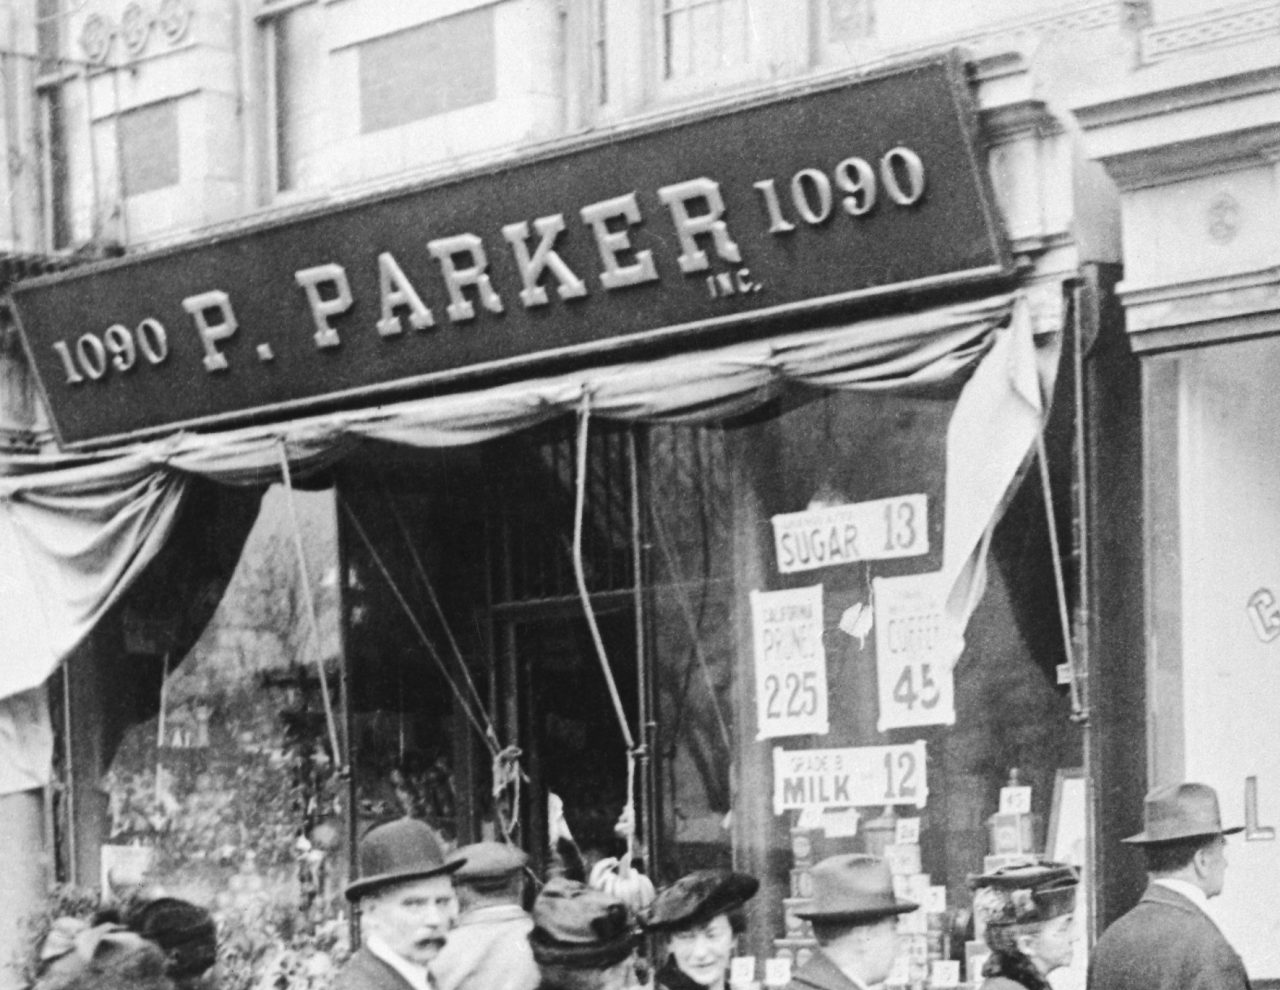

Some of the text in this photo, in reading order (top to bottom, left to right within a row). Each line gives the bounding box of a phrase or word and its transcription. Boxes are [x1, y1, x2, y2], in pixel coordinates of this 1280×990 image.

[53, 144, 926, 385] 1090 P. PARKER 1090
[706, 268, 762, 298] INC.
[781, 523, 859, 566] SUGAR
[884, 502, 916, 550] 13
[892, 663, 940, 710] 45
[783, 751, 917, 804] MILK 12
